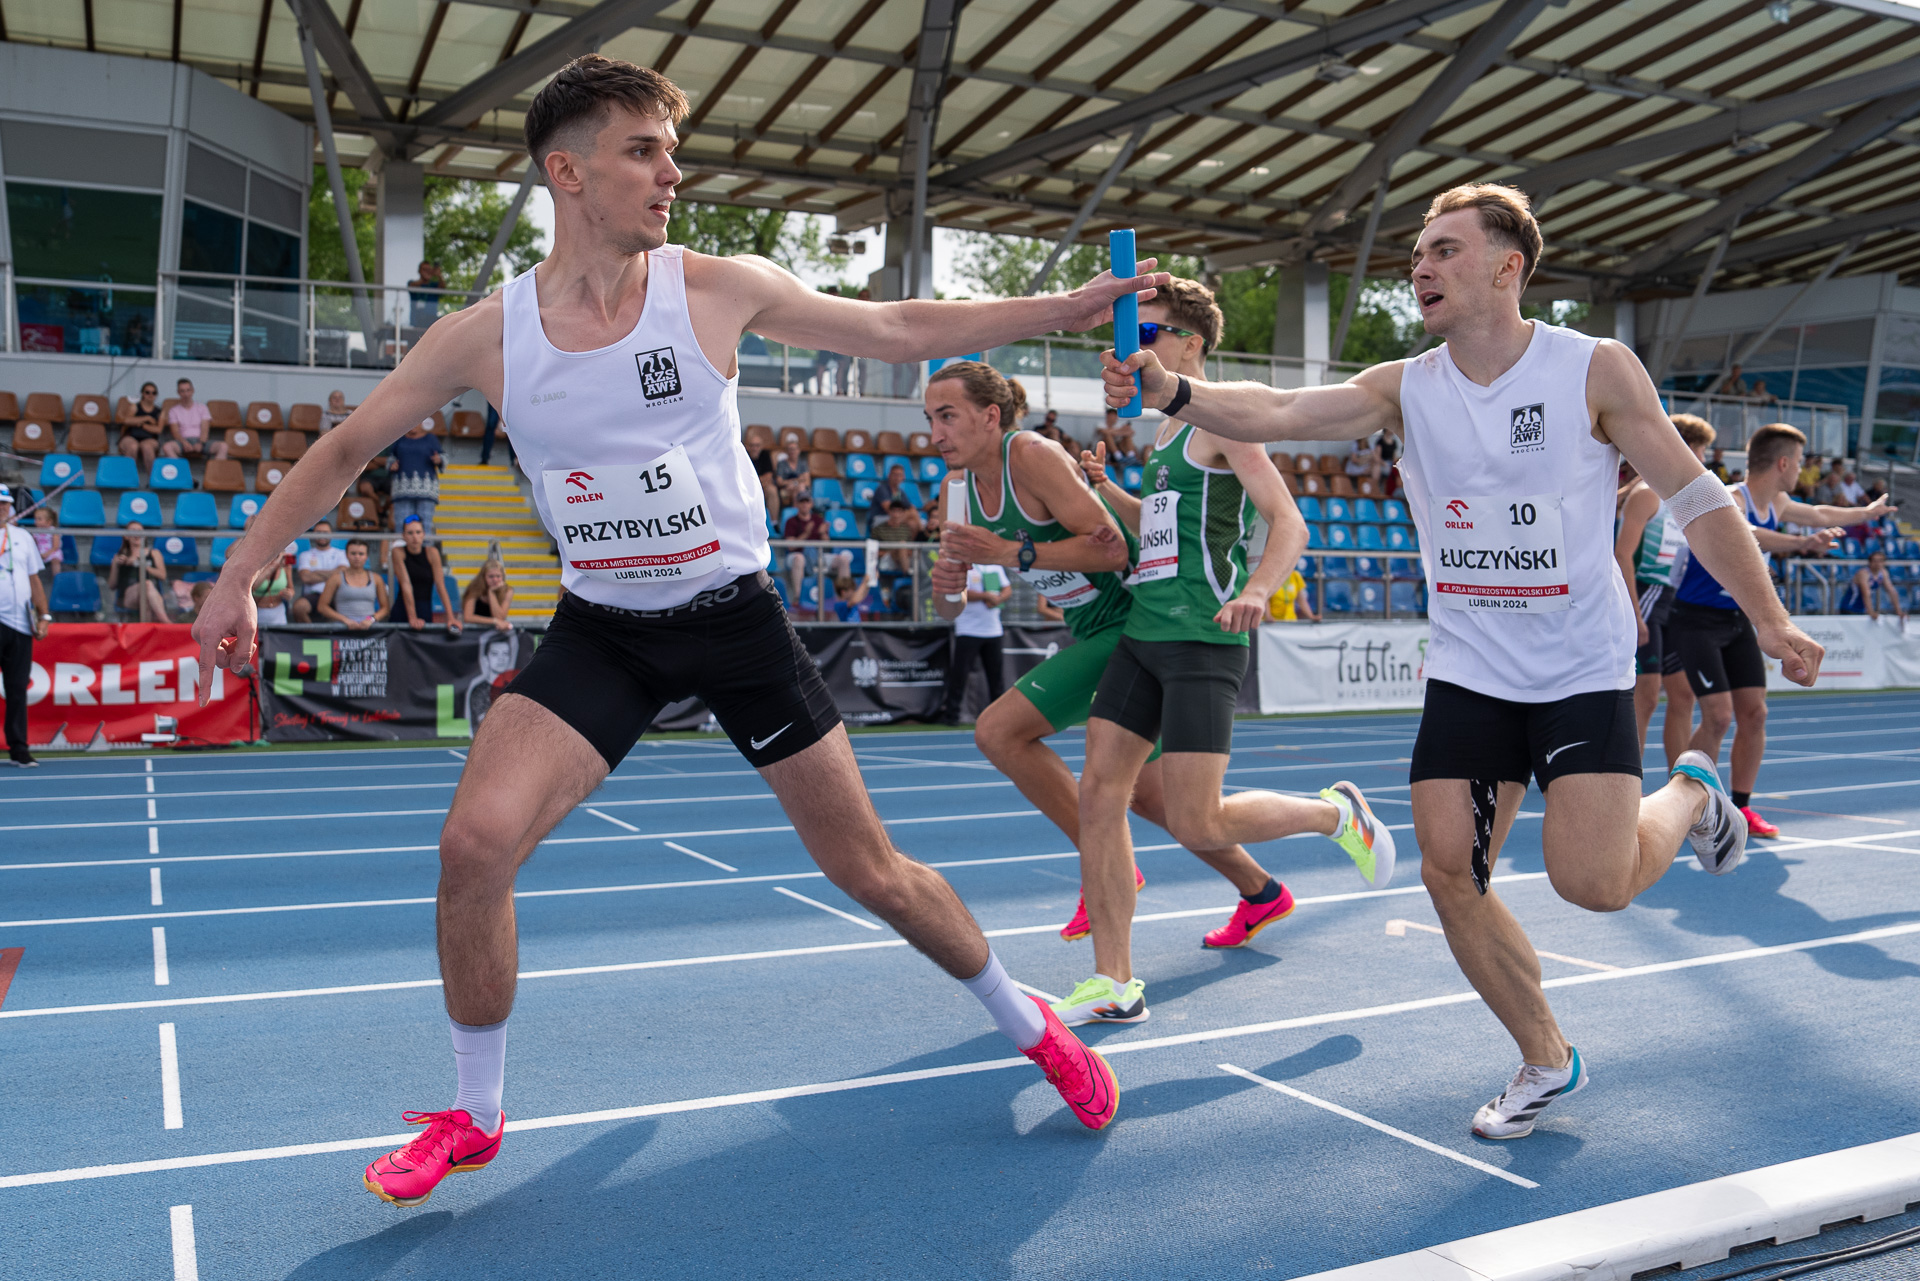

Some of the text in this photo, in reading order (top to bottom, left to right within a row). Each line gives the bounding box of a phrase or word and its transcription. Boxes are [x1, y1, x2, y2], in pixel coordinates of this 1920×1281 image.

[643, 368, 677, 386] AZS
[645, 379, 678, 396] AWF
[542, 391, 567, 403] JAKO
[645, 396, 684, 409] WROCŁAW
[1513, 421, 1542, 435] AZS
[1513, 431, 1542, 444] AWF
[638, 463, 673, 494] 15
[566, 492, 604, 504] ORLEN
[1153, 496, 1168, 514] 59
[1508, 502, 1537, 526] 10
[563, 504, 707, 544] PRZYBYLSKI
[1445, 521, 1474, 529] ORLEN
[590, 560, 609, 569] PZLA
[609, 557, 667, 568] MISTRZOSTWA
[667, 551, 696, 563] POLSKI
[696, 545, 713, 556] U23
[1440, 545, 1557, 570] ŁUCZYŃSKI
[614, 567, 682, 580] LUBLIN 2024
[1467, 587, 1517, 595] MISTRZOSTWA
[1517, 588, 1543, 596] POLSKI
[1544, 587, 1560, 595] U23
[1468, 599, 1528, 608] LUBLIN 2024
[0, 656, 224, 706] ORLEN
[332, 684, 340, 696] W
